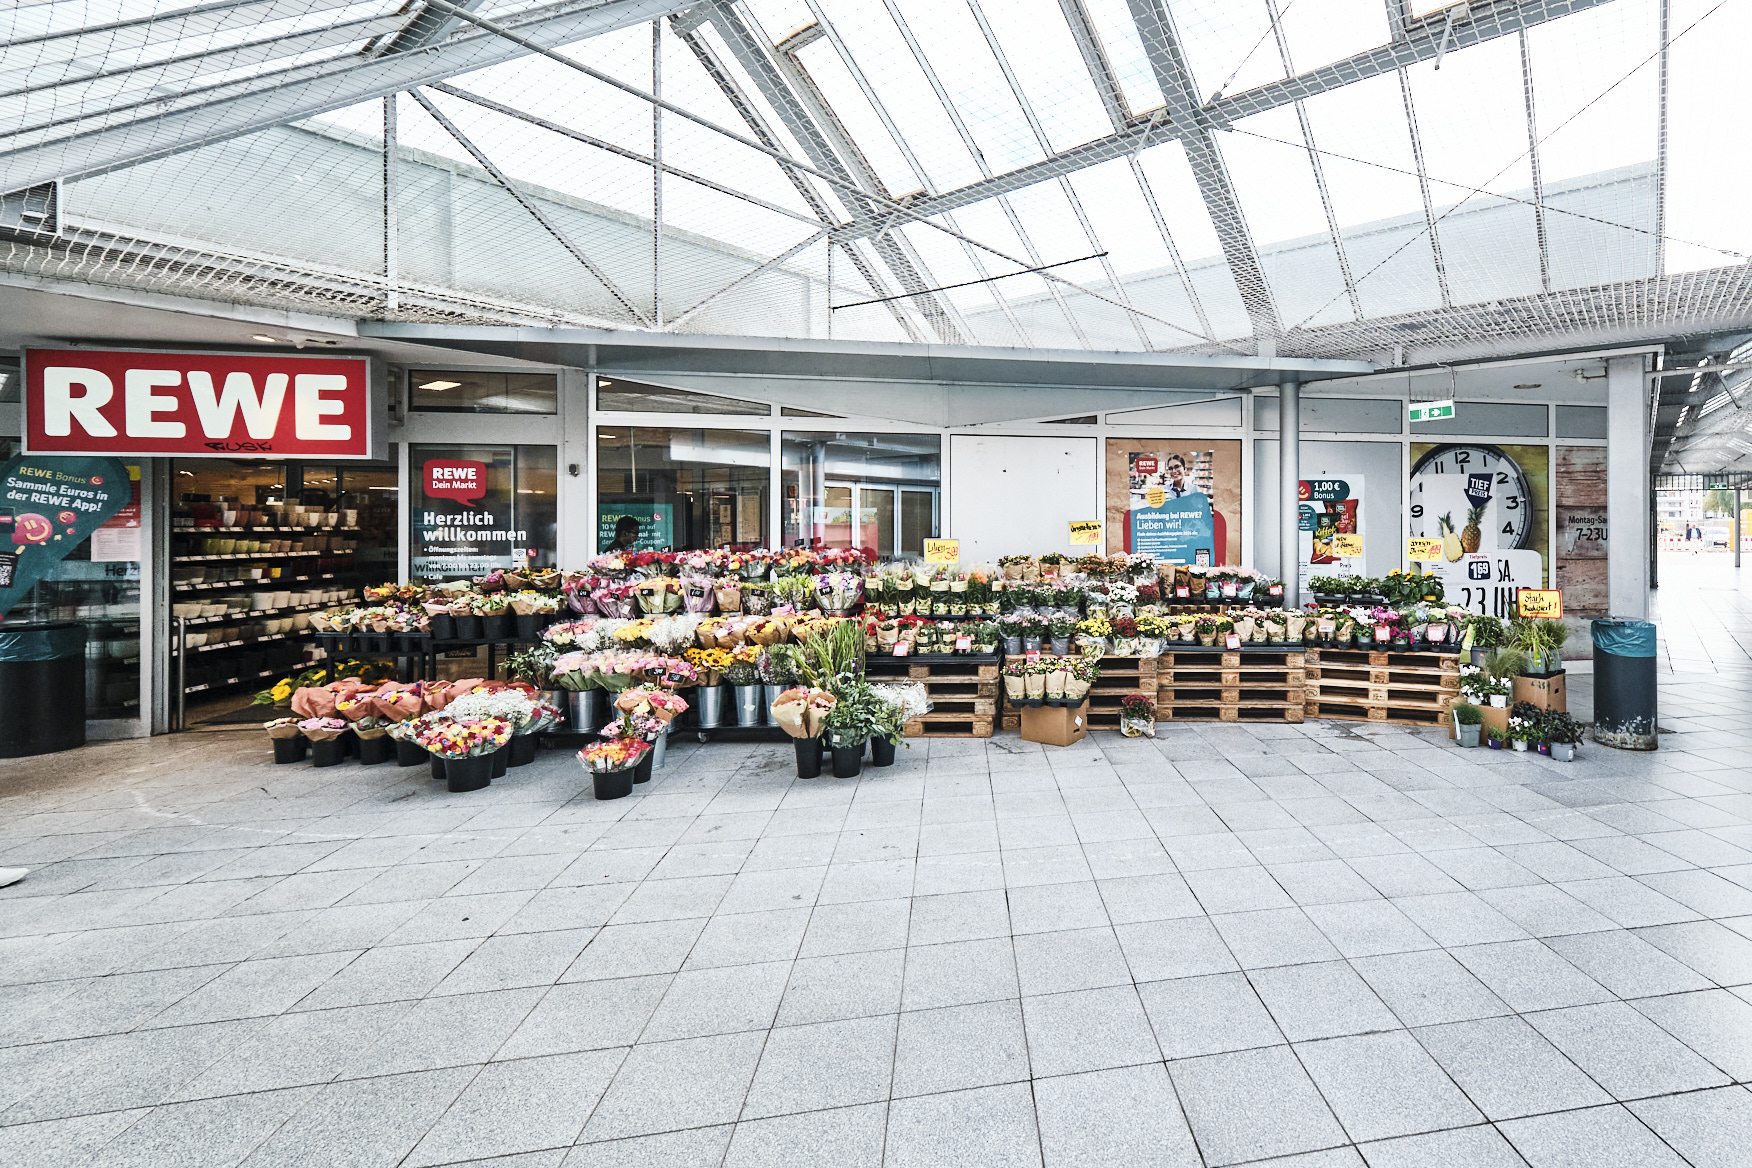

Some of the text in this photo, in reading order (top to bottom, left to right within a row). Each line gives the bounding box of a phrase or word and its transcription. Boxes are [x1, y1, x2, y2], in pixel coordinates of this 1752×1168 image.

[44, 366, 352, 441] REWE
[1454, 451, 1471, 464] 12
[1483, 454, 1487, 467] 1
[432, 467, 477, 479] REWE
[1434, 461, 1444, 474] 11
[19, 466, 86, 484] REWE Bonus
[1496, 472, 1509, 484] 2
[6, 477, 108, 500] Sammle Euros in
[432, 481, 477, 489] Dein Markt
[1313, 482, 1341, 491] 1,00 €
[1470, 477, 1490, 491] TIEF
[6, 490, 103, 512] der REWE App!
[1506, 496, 1519, 509] 3
[1136, 511, 1203, 521] Ausbildung bei REWE?
[1410, 504, 1424, 518] 9
[423, 511, 494, 526] Herzlich
[1136, 519, 1182, 530] Lieben wir!
[1568, 515, 1608, 525] Montag-Sa
[423, 527, 527, 541] willkommen
[1502, 521, 1515, 535] 4
[1575, 527, 1608, 541] 7-23U
[428, 545, 479, 554] Öffnungszeiten:
[1493, 586, 1532, 620] UH
